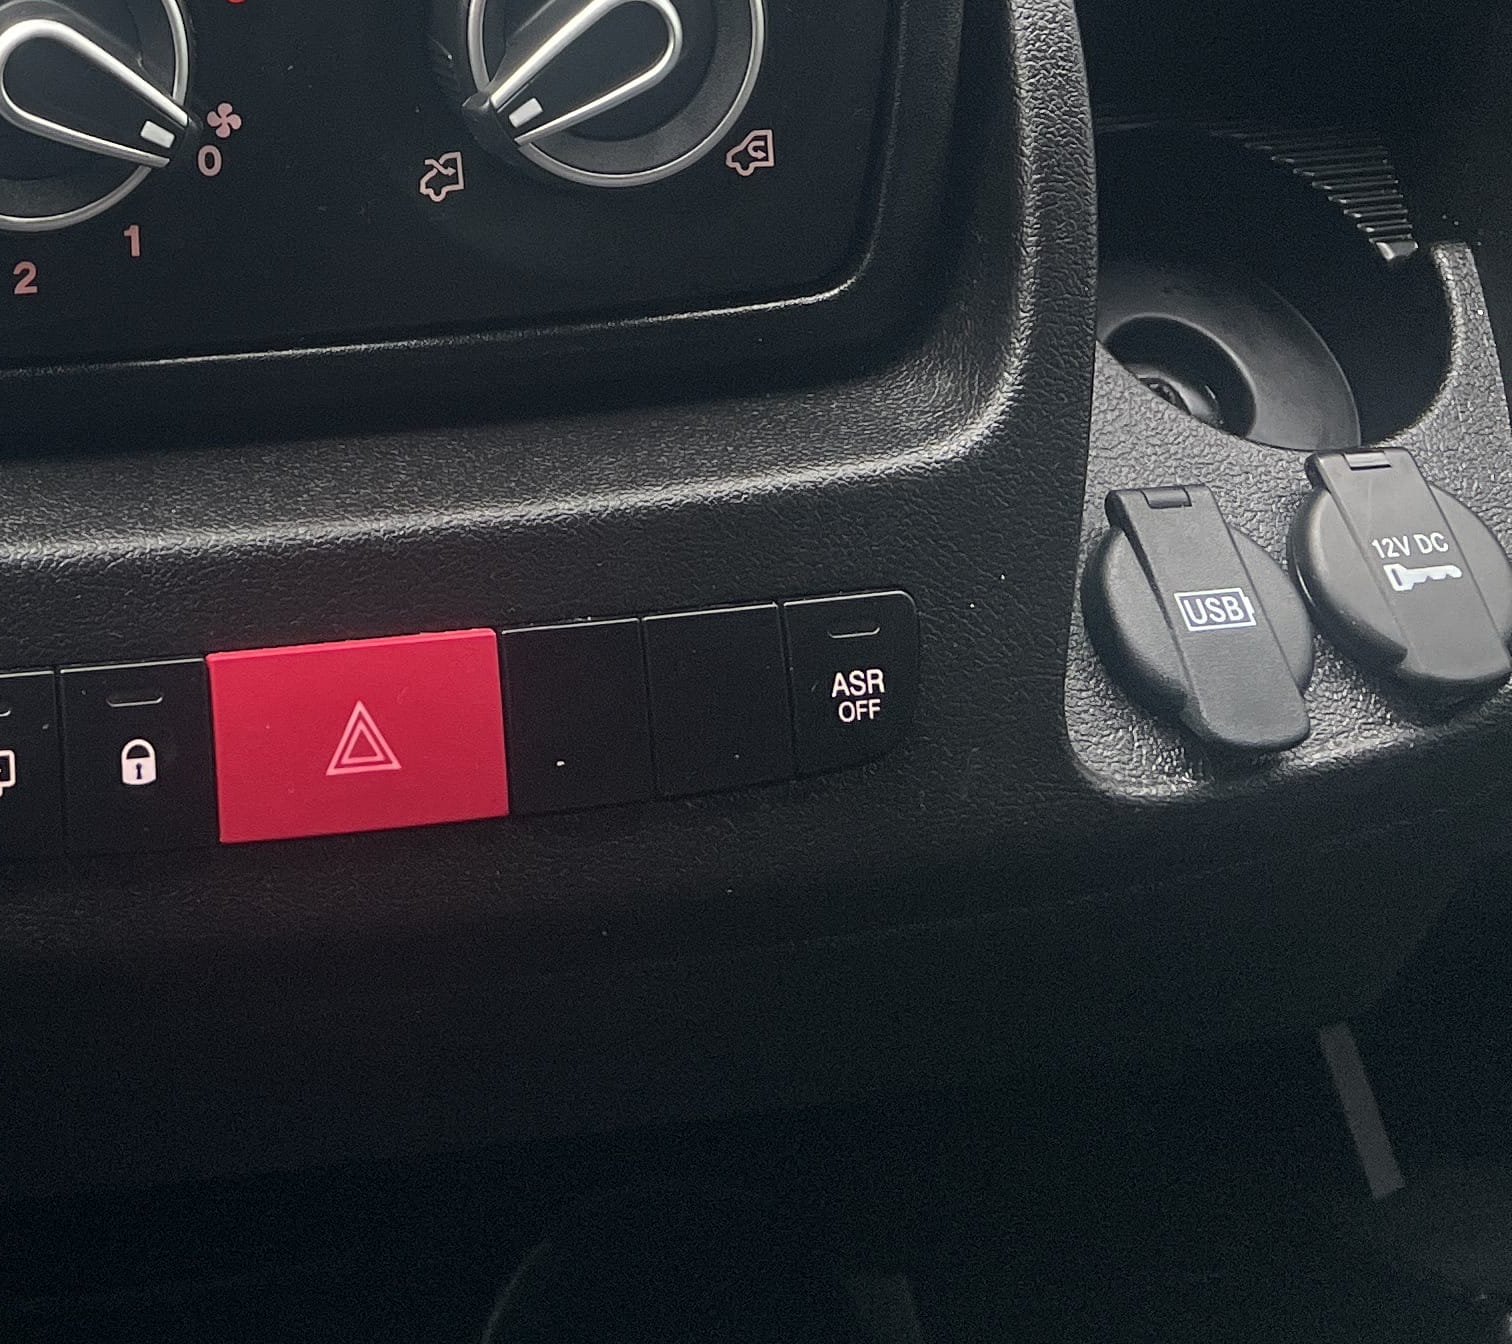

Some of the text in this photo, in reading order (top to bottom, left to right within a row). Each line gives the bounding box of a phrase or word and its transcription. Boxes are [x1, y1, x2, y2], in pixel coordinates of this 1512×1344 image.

[197, 144, 222, 177] 0
[123, 224, 141, 257] 1
[13, 261, 38, 295] 2
[1371, 531, 1449, 559] 12V DC
[1186, 596, 1245, 625] USB
[831, 668, 885, 698] ASR
[838, 698, 881, 723] OFF
